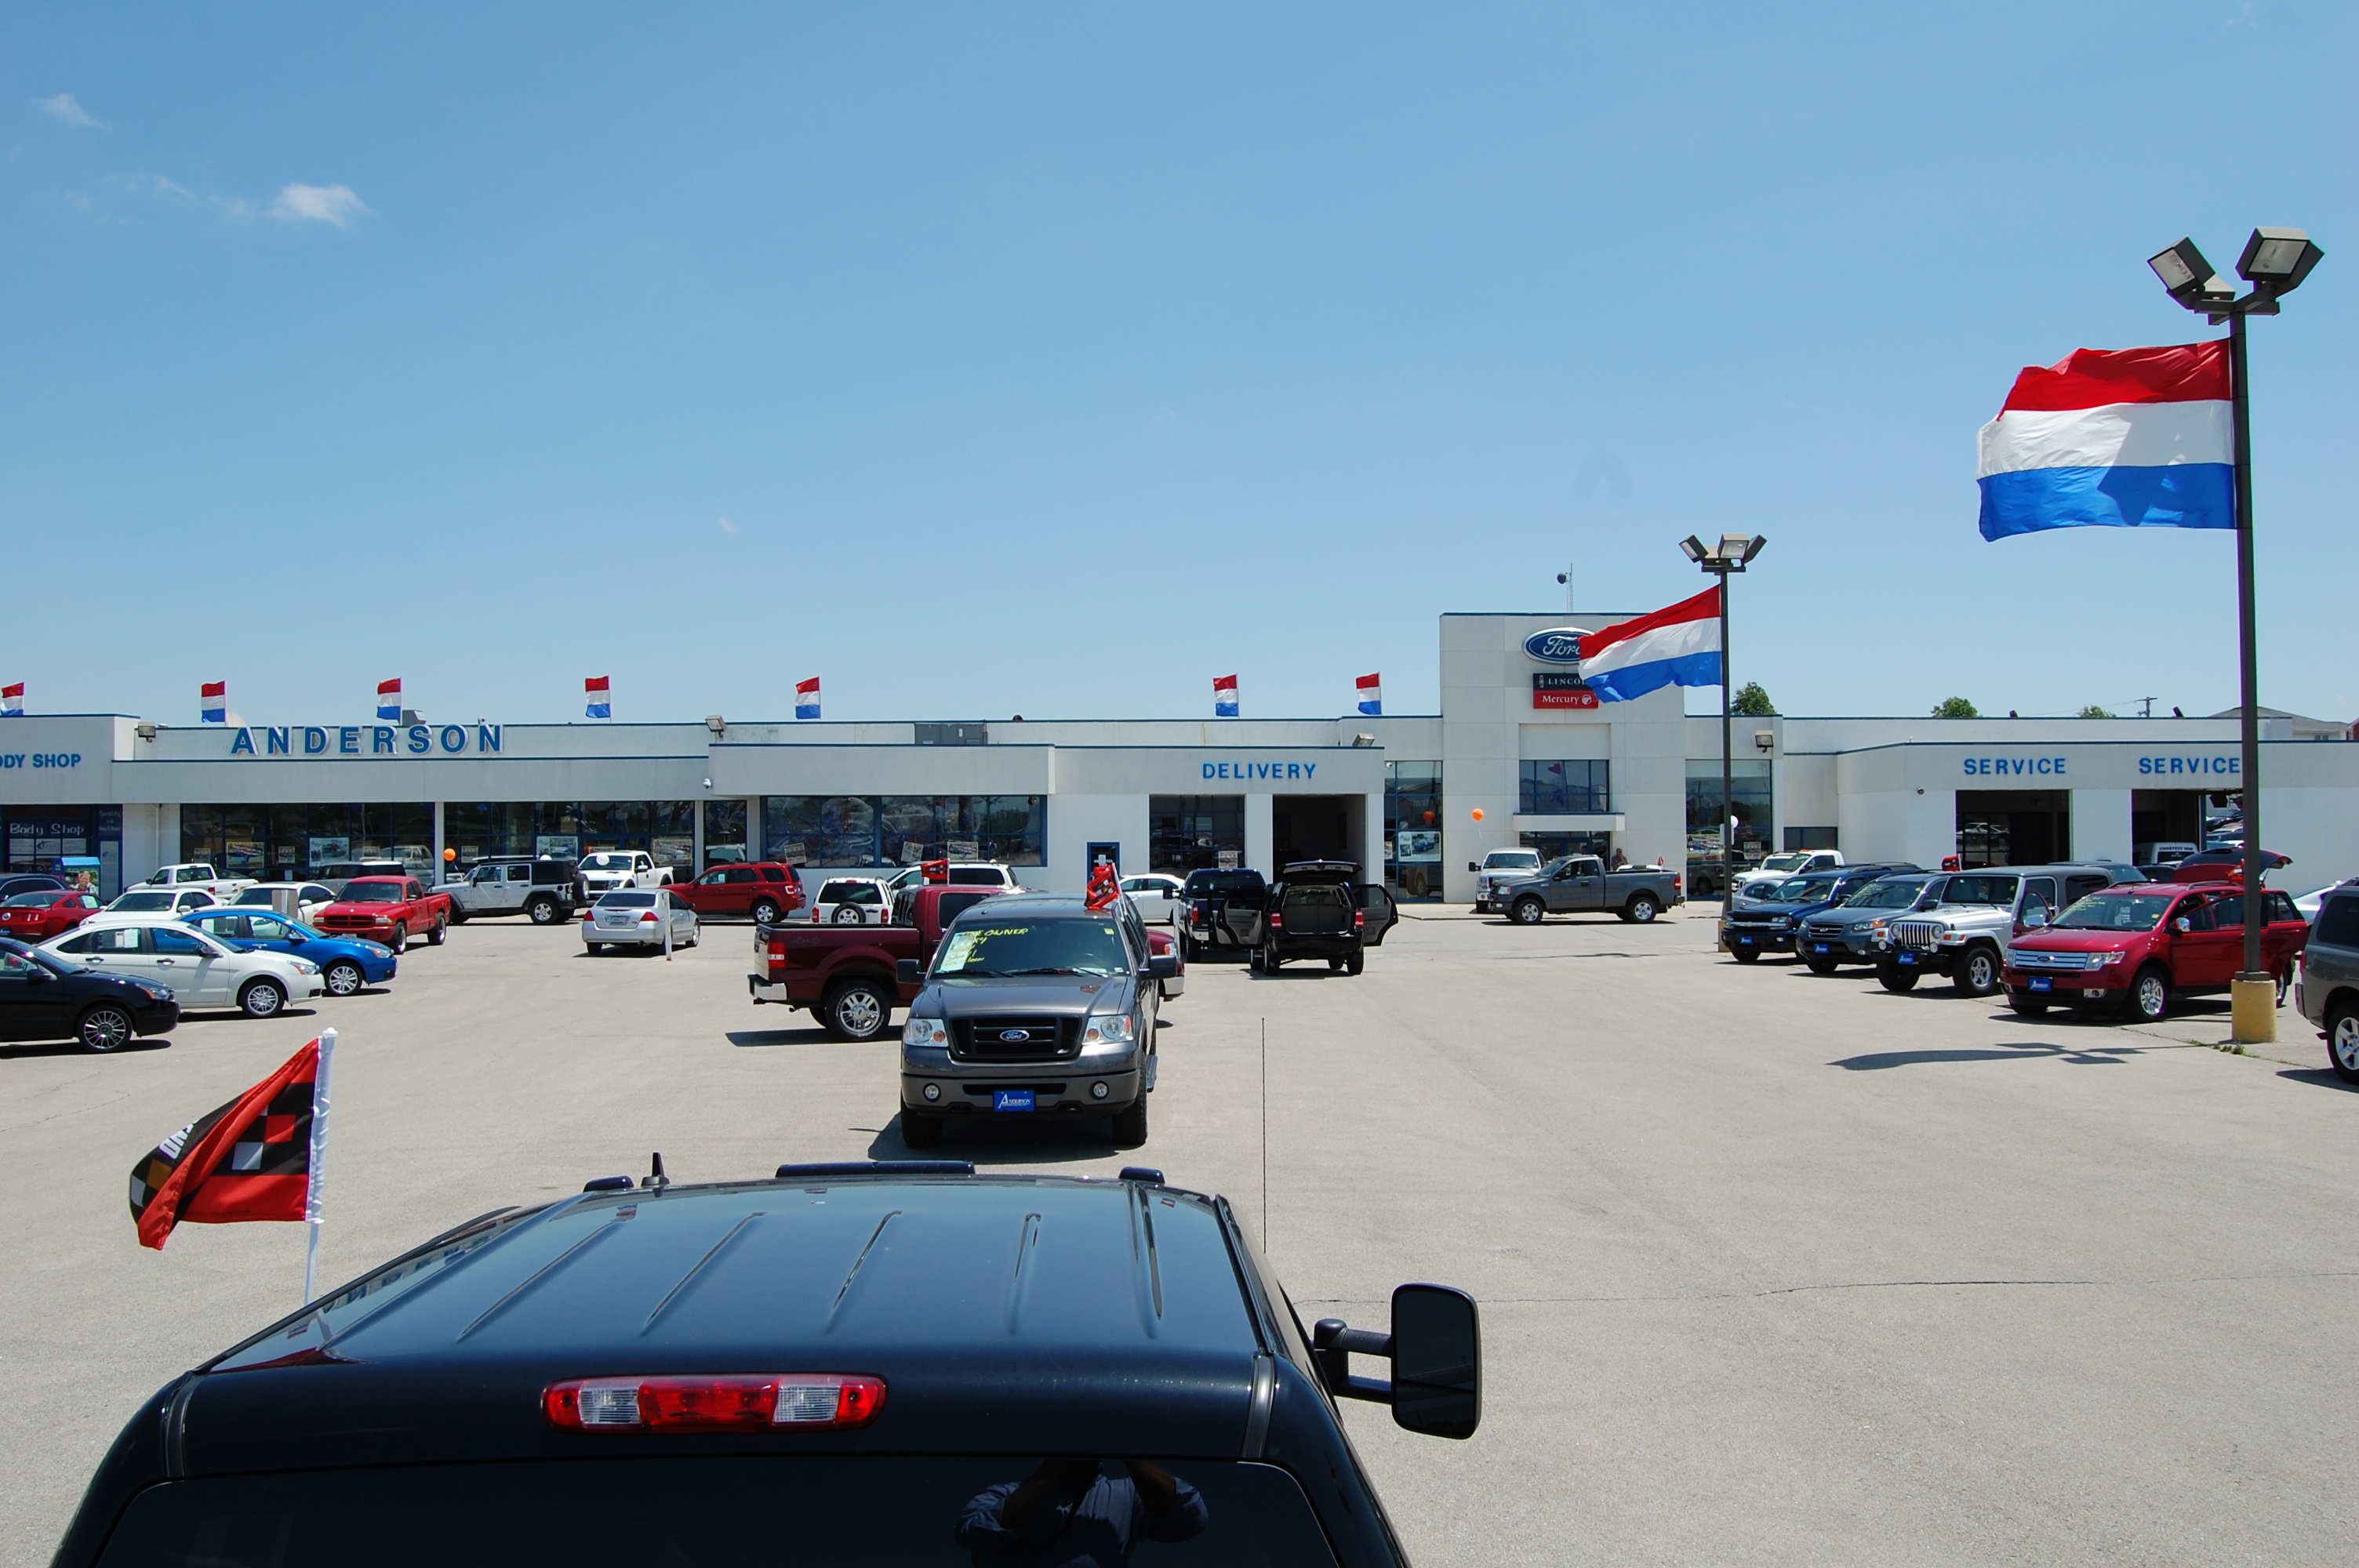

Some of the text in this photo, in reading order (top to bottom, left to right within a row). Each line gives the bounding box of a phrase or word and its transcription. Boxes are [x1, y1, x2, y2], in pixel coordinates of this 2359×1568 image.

[1542, 695, 1579, 705] Mercury
[231, 724, 503, 755] ANDERSON
[32, 753, 82, 768] SHOP
[1963, 757, 2066, 775] SERVICE
[2139, 757, 2241, 775] SERVICE
[1202, 762, 1317, 779] DELIVERY
[9, 823, 84, 836] Body Shop
